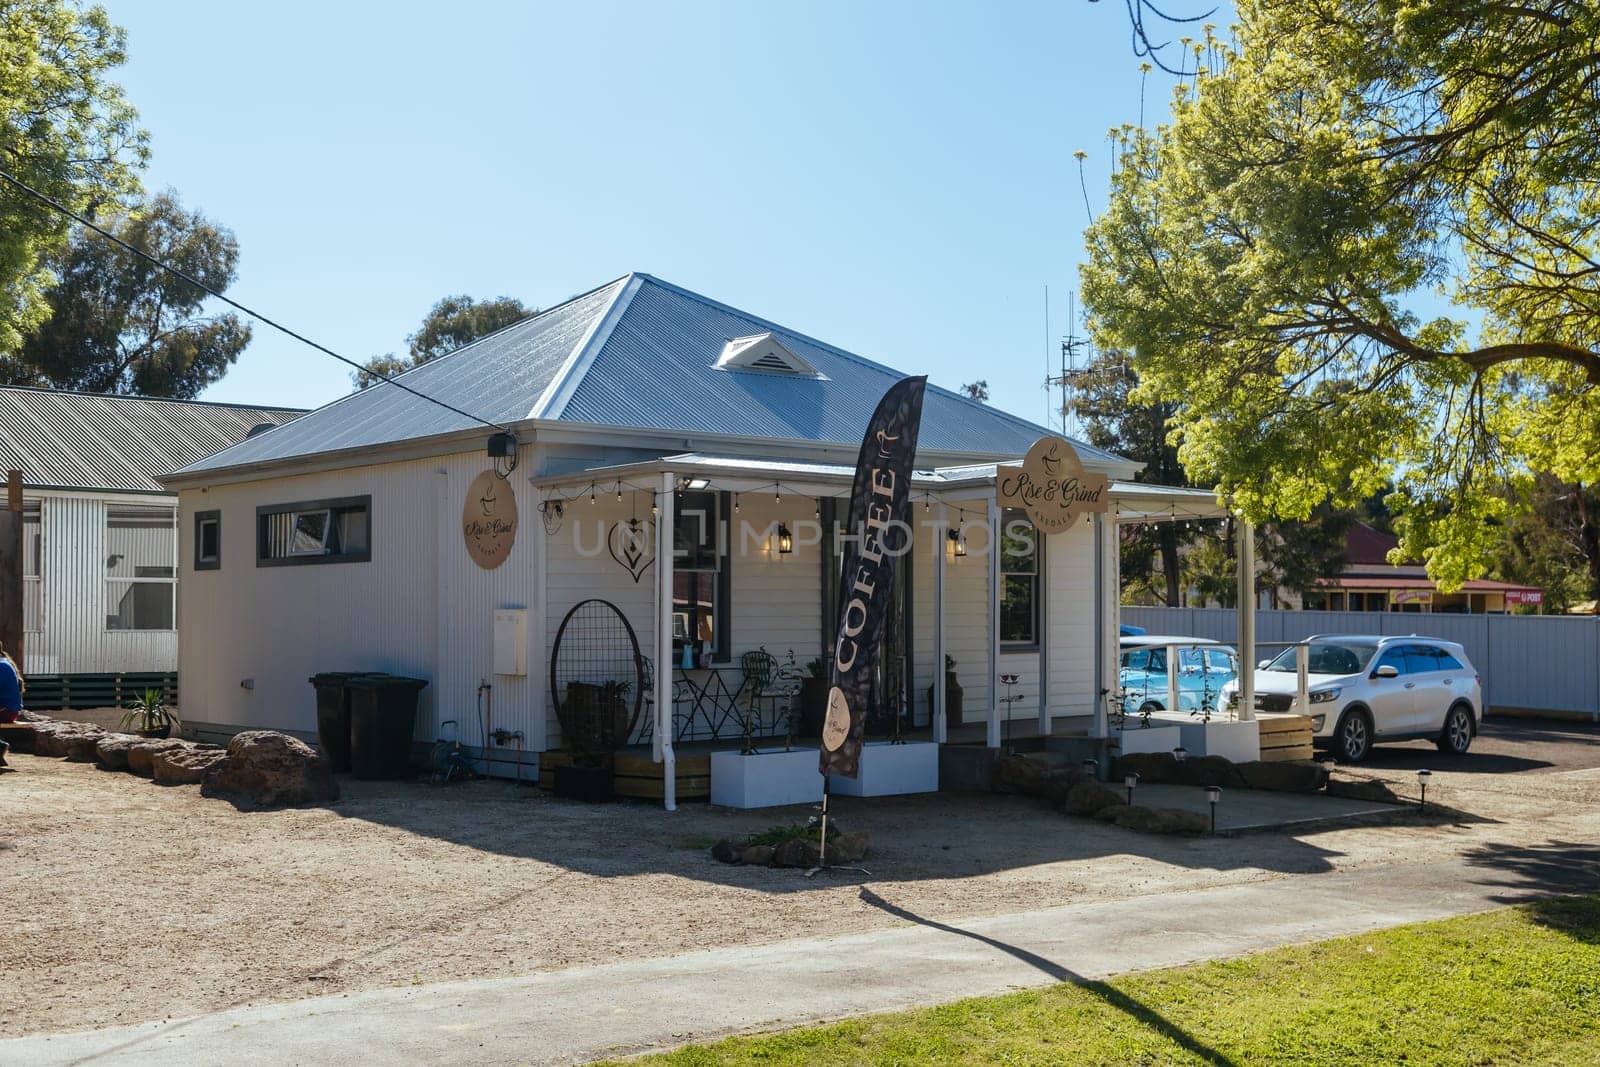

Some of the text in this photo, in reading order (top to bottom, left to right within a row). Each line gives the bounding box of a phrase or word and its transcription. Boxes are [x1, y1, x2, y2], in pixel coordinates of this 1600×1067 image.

[1002, 472, 1103, 508] Rise & Grind
[837, 468, 895, 673] COFFEE
